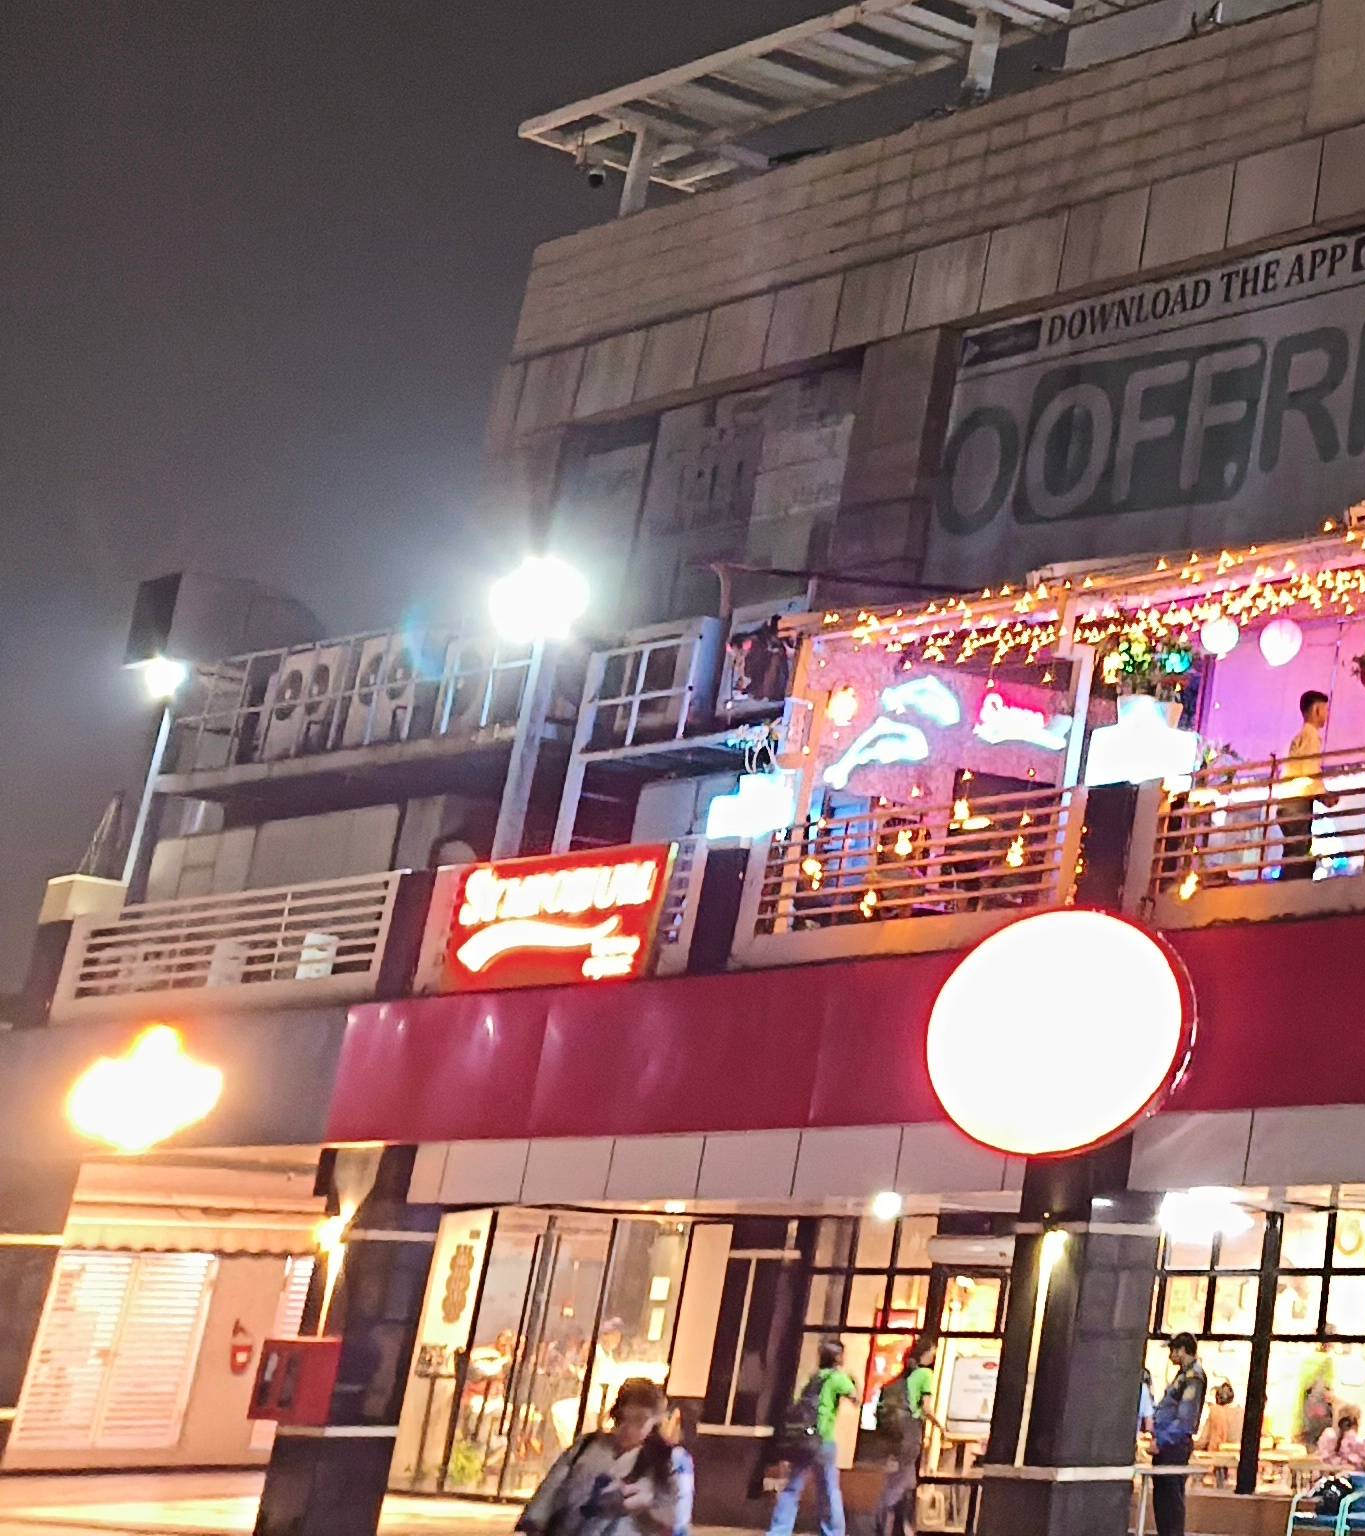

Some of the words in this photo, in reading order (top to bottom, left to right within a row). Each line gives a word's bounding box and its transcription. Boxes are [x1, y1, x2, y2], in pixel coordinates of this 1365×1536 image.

[1047, 278, 1211, 346] DOWNLOAD
[1220, 258, 1280, 303] THE
[1284, 243, 1348, 288] APP
